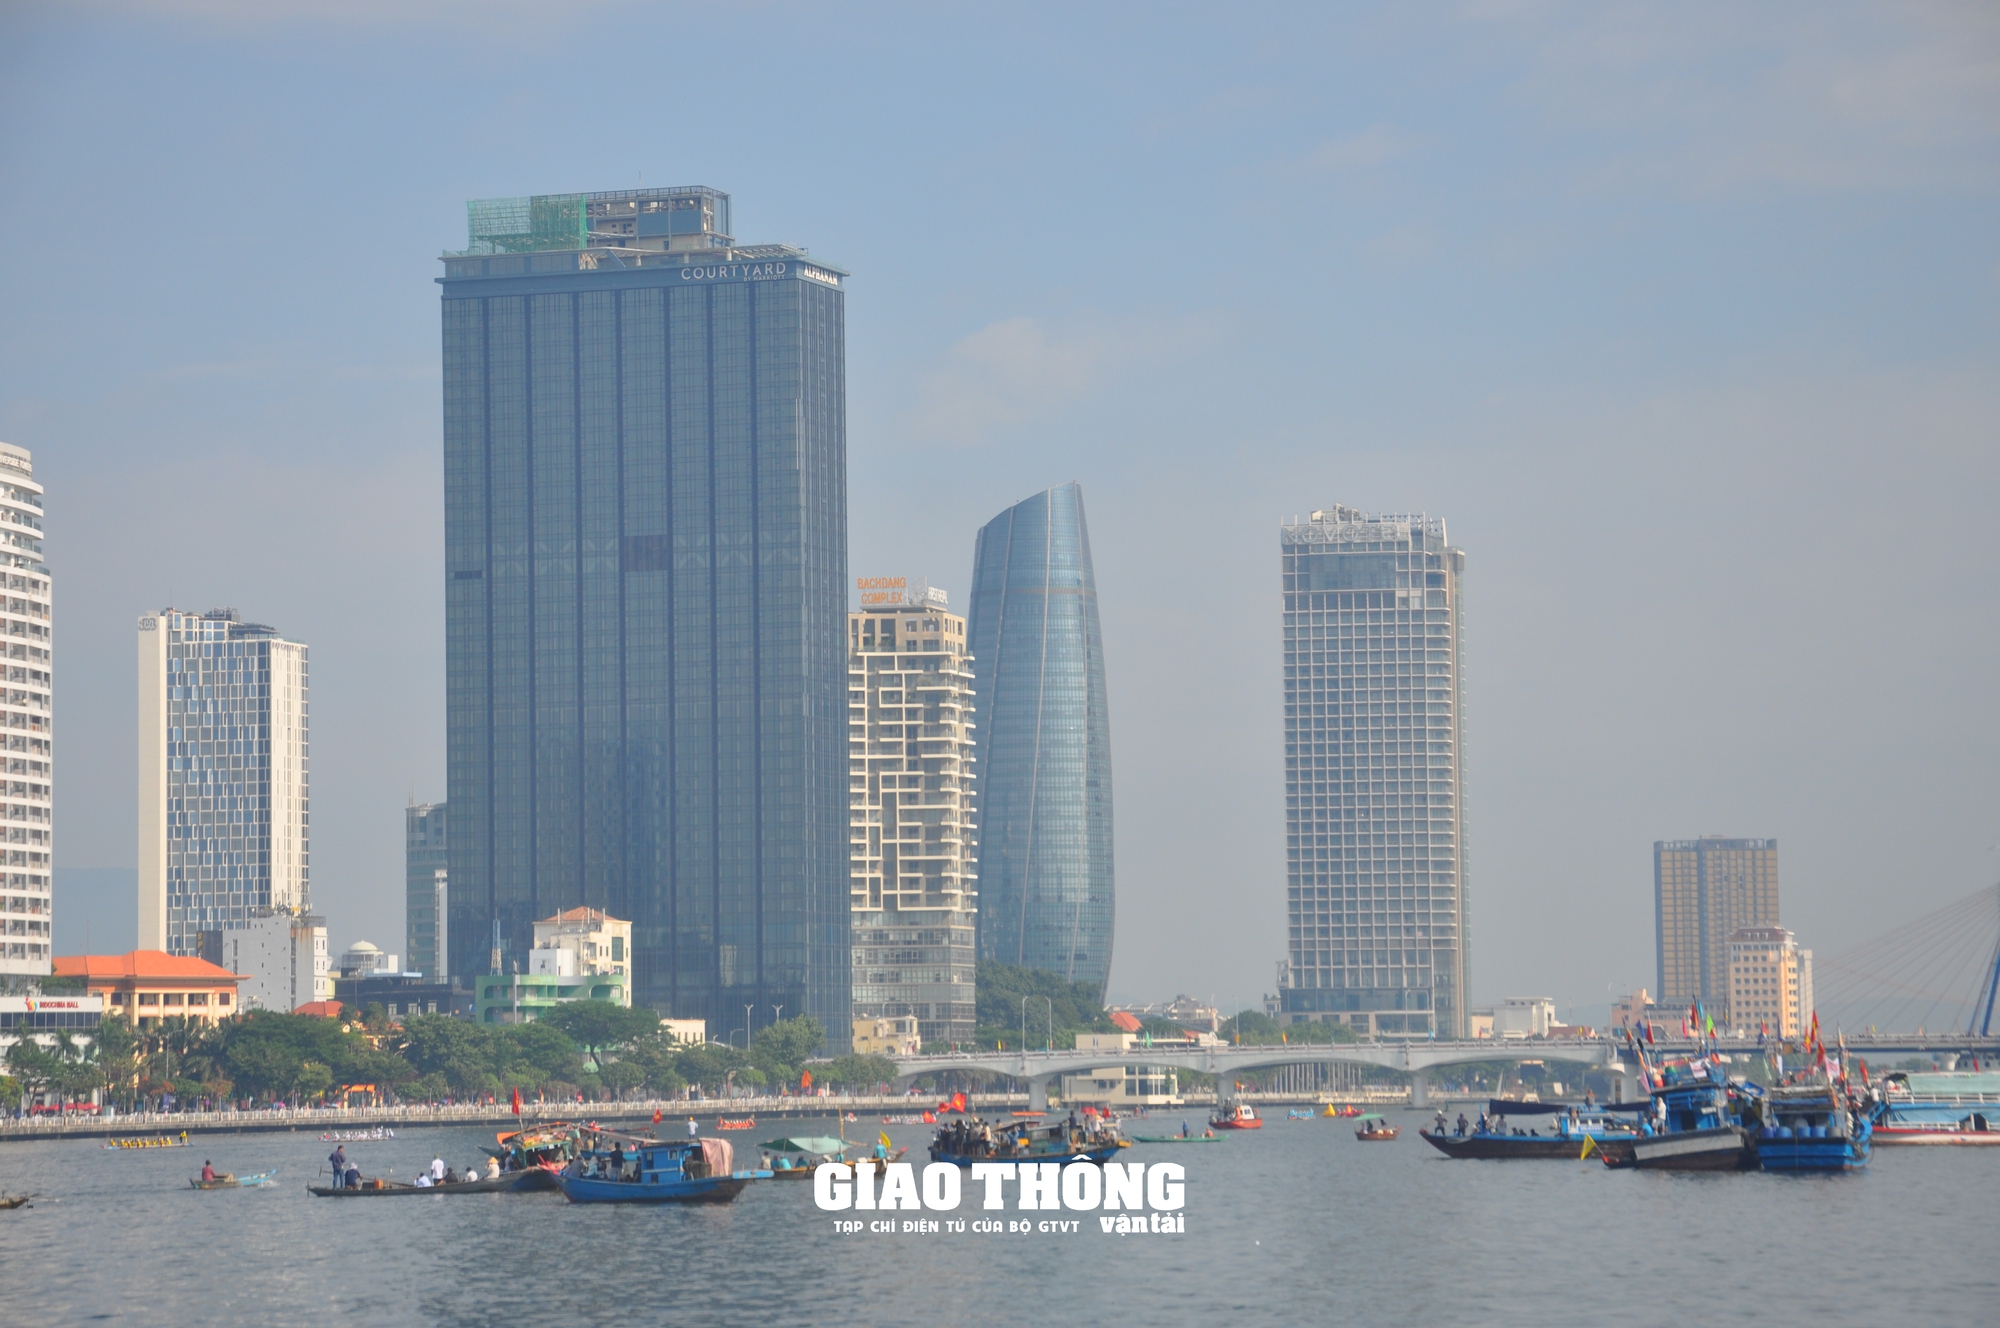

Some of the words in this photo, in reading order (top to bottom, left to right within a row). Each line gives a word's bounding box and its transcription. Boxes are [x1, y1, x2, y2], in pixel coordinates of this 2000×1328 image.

[681, 262, 786, 280] COURTYARD
[803, 264, 838, 286] ALPHANAM
[1281, 524, 1409, 545] NOVOTEL
[857, 577, 906, 589] BACHDANG
[861, 591, 903, 604] COMPLEX
